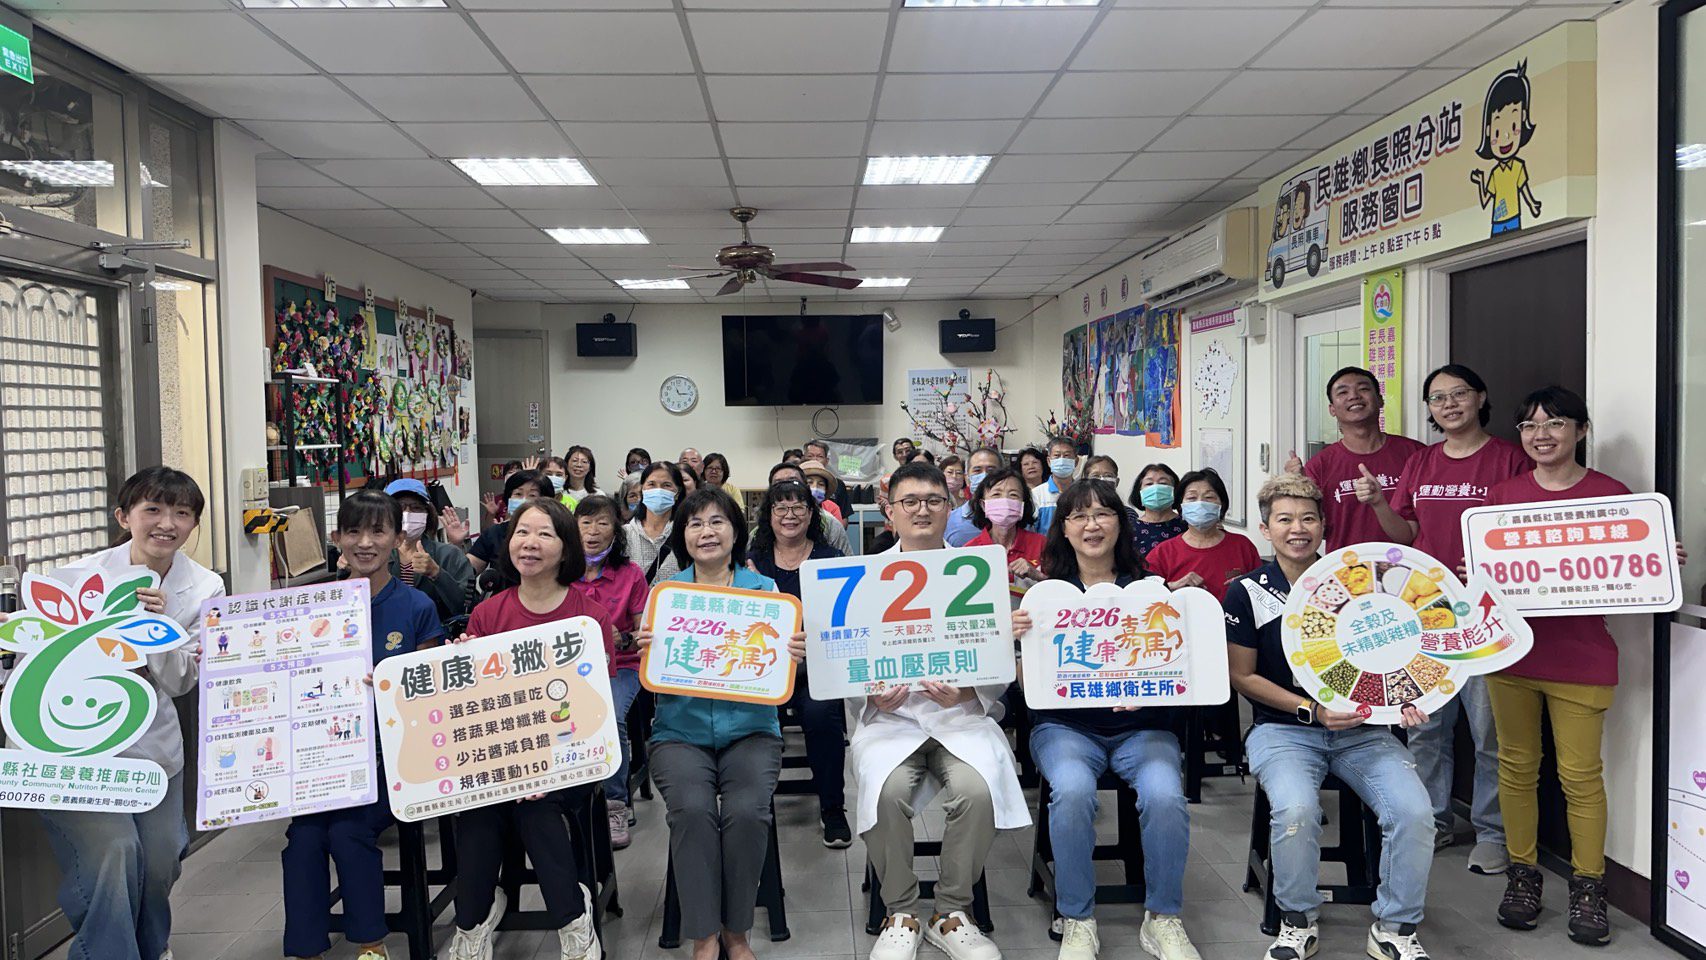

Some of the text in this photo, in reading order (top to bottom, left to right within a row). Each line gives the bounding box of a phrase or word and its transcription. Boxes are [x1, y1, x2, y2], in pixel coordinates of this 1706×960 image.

[5, 59, 28, 76] EXIT
[1316, 102, 1462, 203] 民雄鄉長照分站
[1342, 174, 1422, 238] 服務窗口
[1512, 508, 1630, 525] 嘉義縣社區營養推廣中心
[1504, 523, 1629, 546] 營養諮詢專線
[228, 588, 343, 614] 認識代謝症候群
[671, 593, 780, 620] 嘉義縣衛生局
[667, 616, 727, 636] 2026
[946, 618, 996, 631] 每次量2遍
[1054, 607, 1120, 628] 2026
[1349, 608, 1398, 635] 全穀及
[820, 627, 870, 642] 連續量7天
[883, 624, 933, 637] 一天量2次
[1342, 620, 1421, 657] 未精製雜糧
[401, 632, 584, 698] 健康4撇步
[847, 648, 978, 683] 量血壓原則
[1070, 680, 1174, 698] 民雄鄉衛生所
[449, 687, 543, 719] 選全穀適量吃
[453, 710, 547, 743] 搭蔬果增纖維
[456, 734, 550, 766] 少沾醬減負擔
[2, 761, 160, 786] 縣社區營養推廣中心
[22, 780, 64, 790] Community
[460, 760, 548, 790] 規律運動150
[0, 791, 45, 803] 600786
